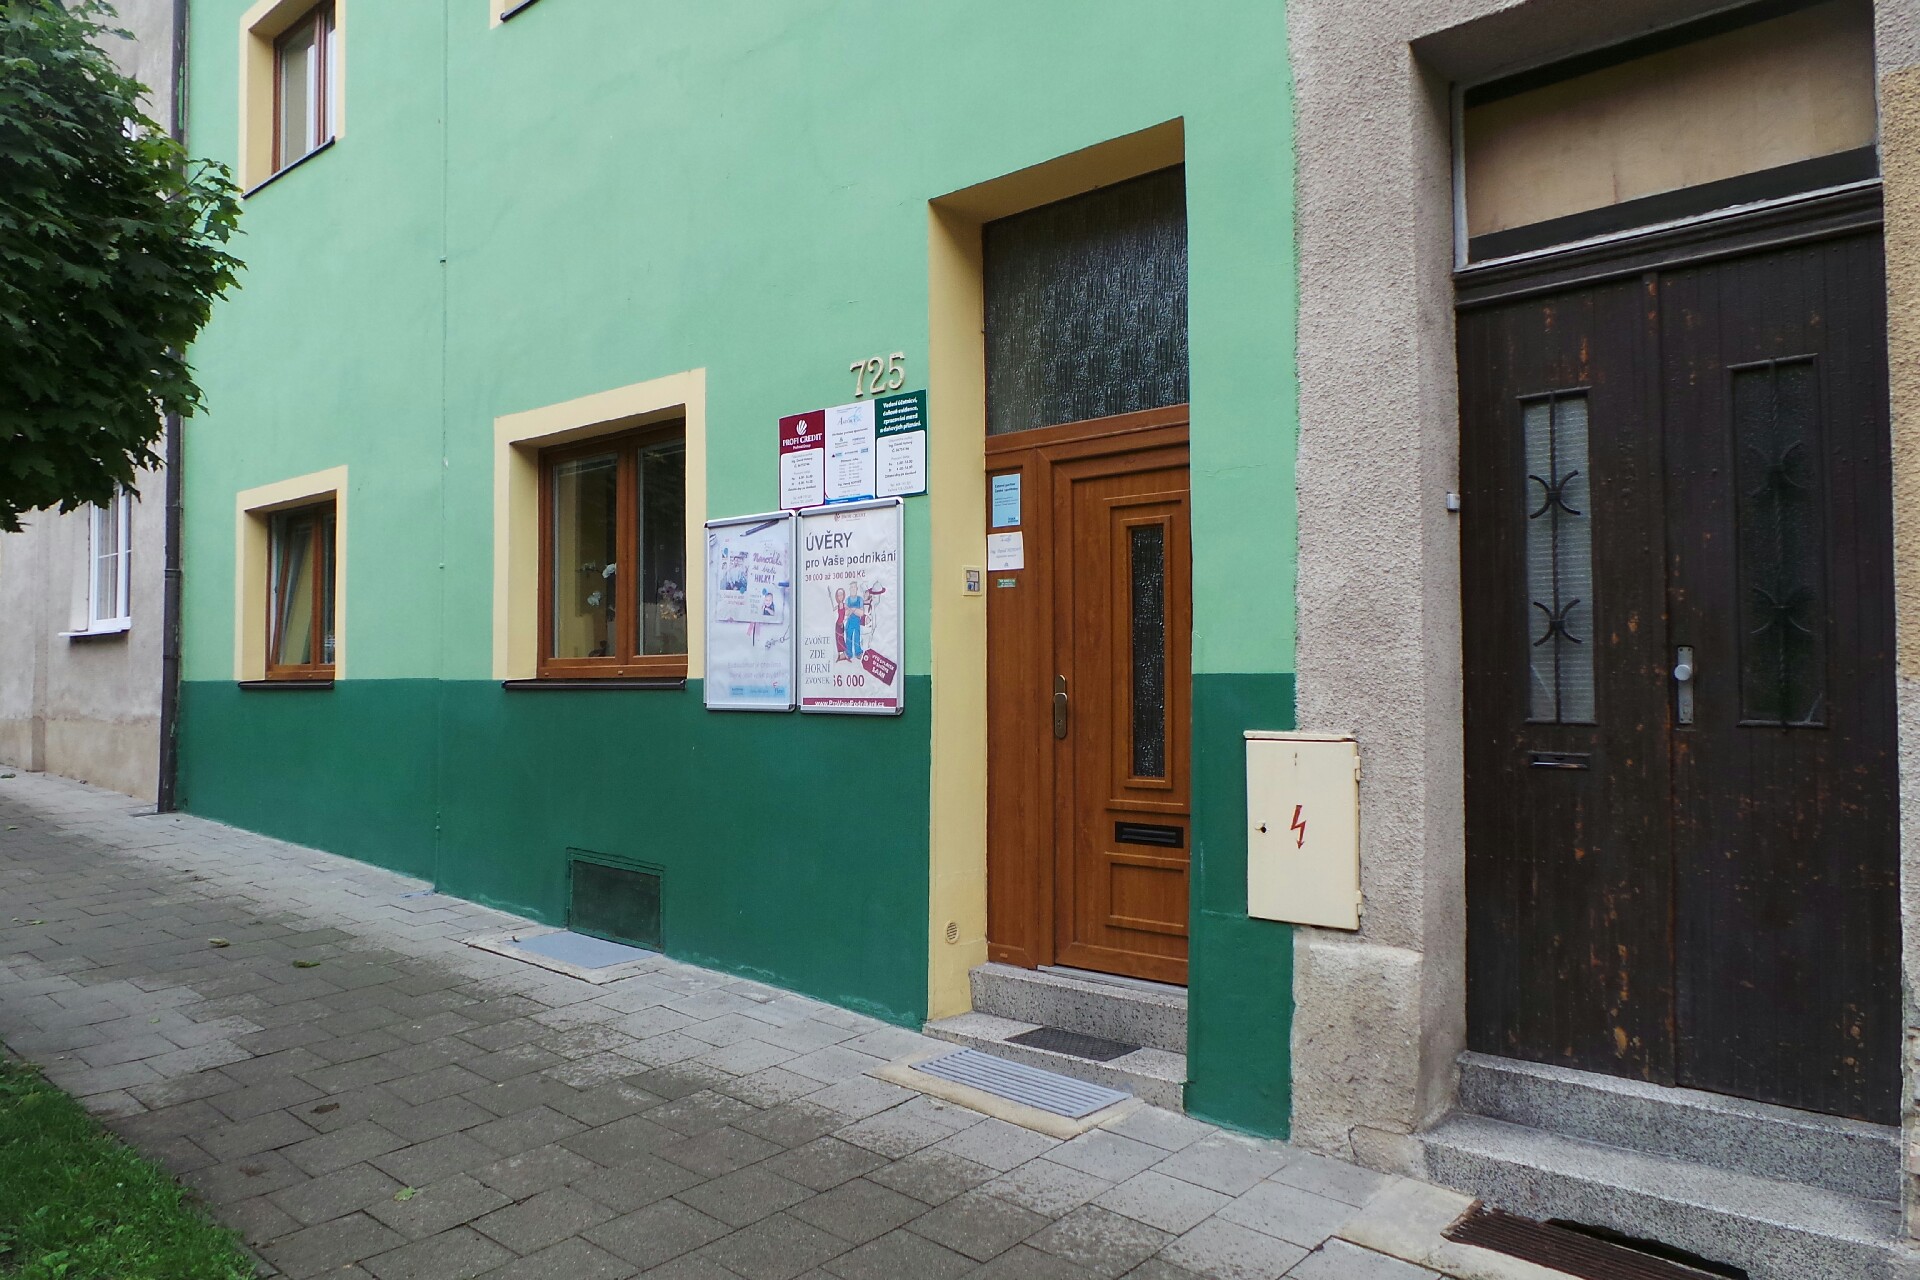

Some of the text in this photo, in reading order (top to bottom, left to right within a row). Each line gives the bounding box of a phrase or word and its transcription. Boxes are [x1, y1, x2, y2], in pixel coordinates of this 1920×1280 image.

[850, 352, 905, 397] 725
[782, 433, 823, 447] PROFI CREDIT
[806, 530, 853, 552] ÚVĚRY
[805, 550, 897, 571] pro Vaše podnikání
[812, 573, 823, 581] 000
[844, 570, 856, 579] 000
[856, 570, 866, 578] Kč
[809, 649, 826, 659] ZDE
[804, 661, 831, 674] HORNÍ
[804, 676, 831, 685] ZVONEK
[846, 674, 865, 687] 000
